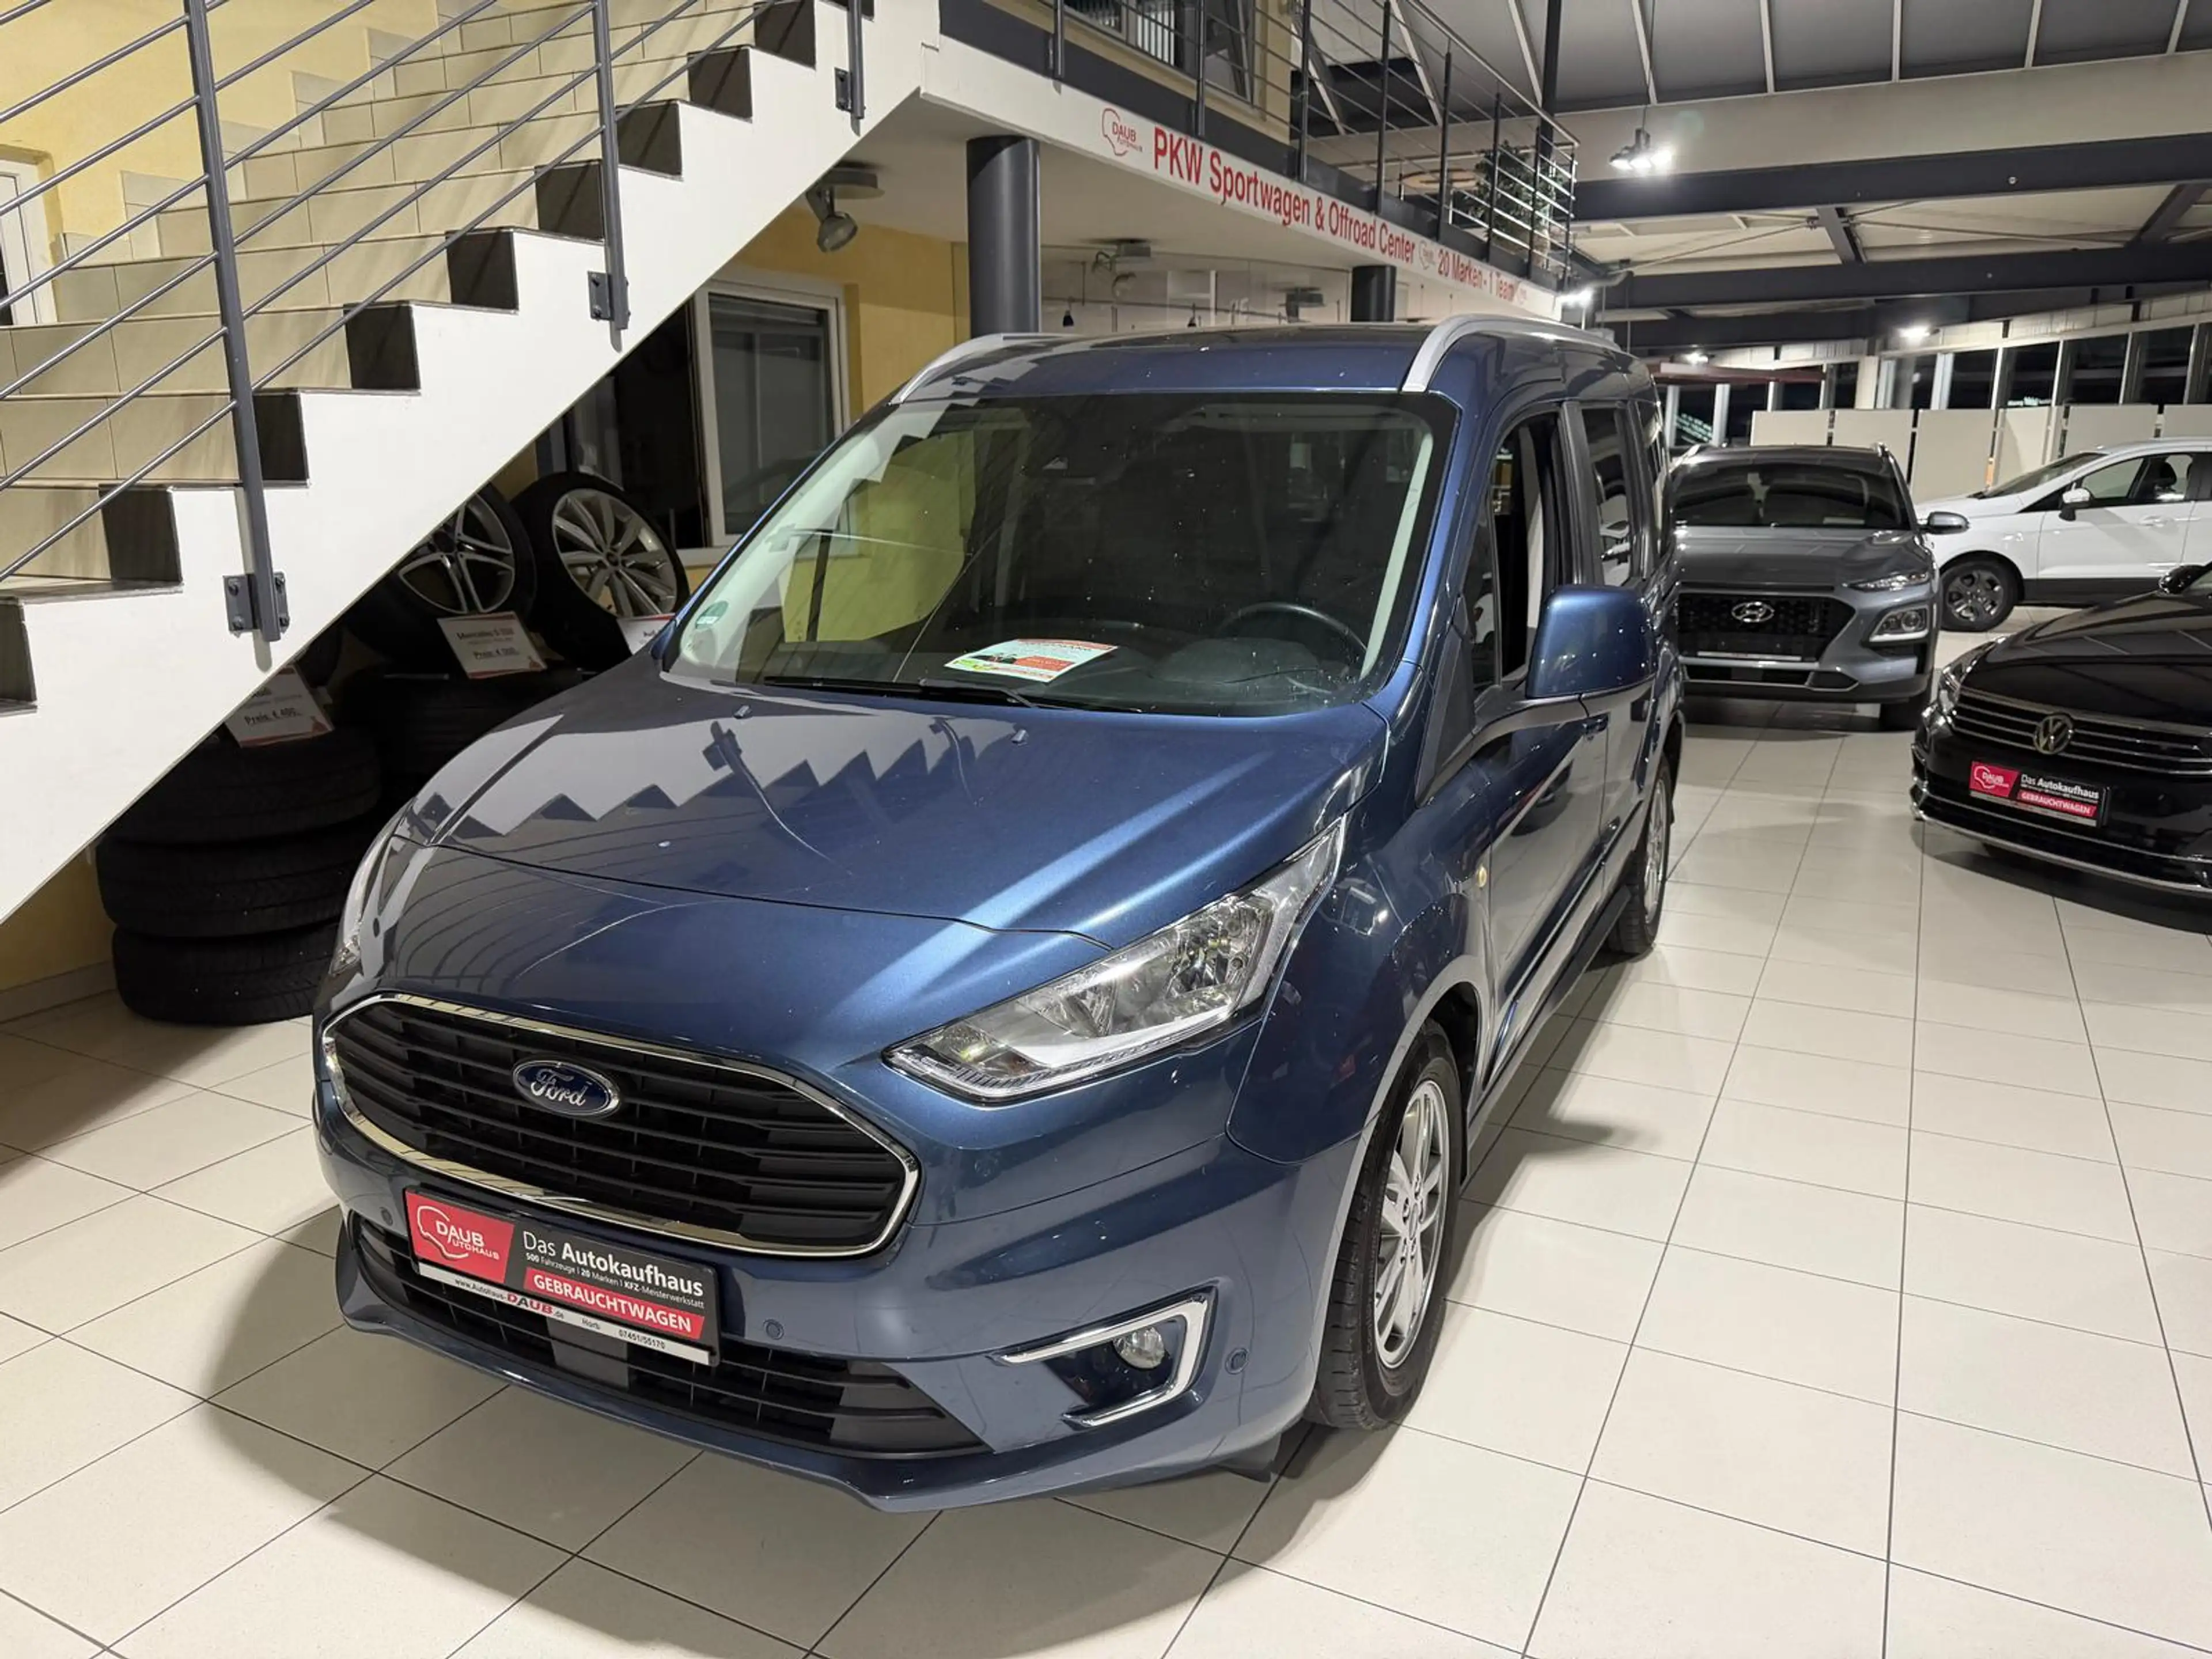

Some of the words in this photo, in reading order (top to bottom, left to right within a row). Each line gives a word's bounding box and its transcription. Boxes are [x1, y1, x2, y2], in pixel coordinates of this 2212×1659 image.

[1112, 122, 1137, 143] DAUB
[1154, 126, 1203, 185] PKW
[1210, 150, 1310, 226] Sportwagen
[1315, 196, 1325, 231] &
[1329, 201, 1377, 249] Offroad
[1379, 222, 1415, 264] Center
[1438, 249, 1450, 277] 20
[1452, 253, 1483, 289] Marken
[2021, 774, 2036, 785] Das
[2037, 778, 2099, 800] Autokaufhaus
[531, 1069, 592, 1106] Ford
[435, 1219, 484, 1247] DAUB
[523, 1230, 556, 1256] Das
[562, 1242, 703, 1297] Autokaufhaus
[525, 1252, 540, 1263] 500
[581, 1268, 591, 1278] 20
[624, 1280, 704, 1309] KFZ-Meisterwerkstatt
[533, 1274, 692, 1332] GEBRAUCHTWAGEN
